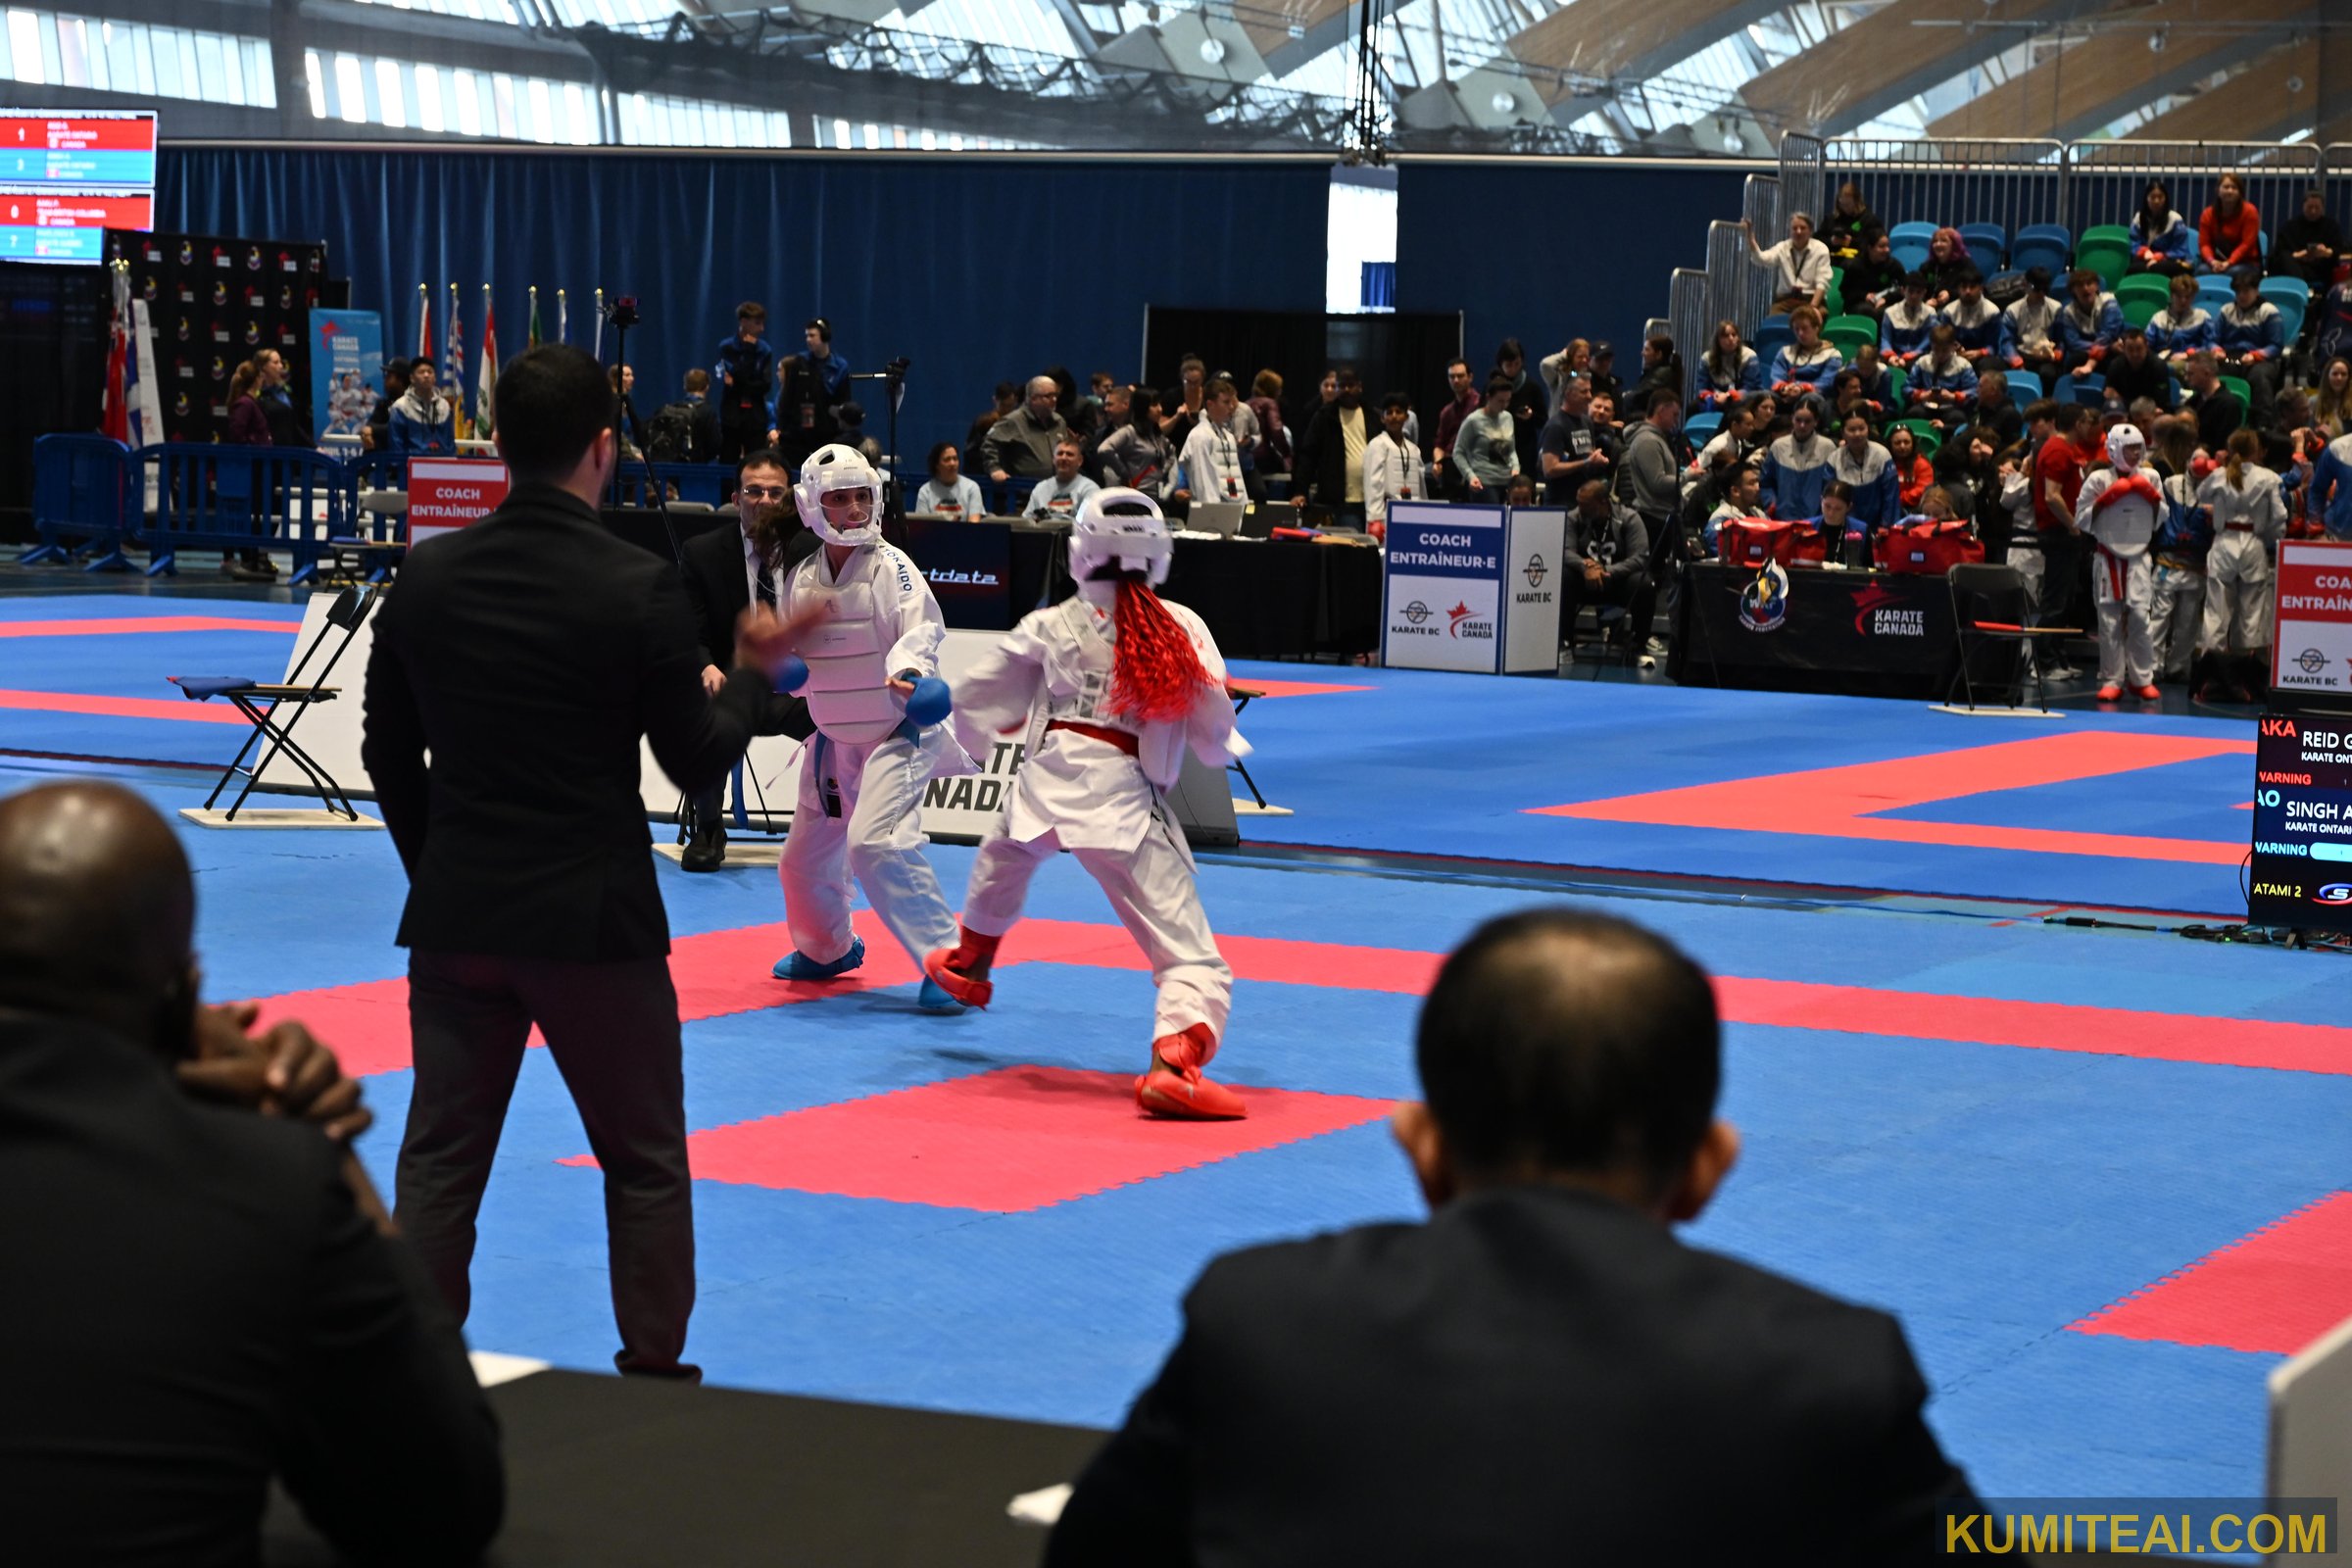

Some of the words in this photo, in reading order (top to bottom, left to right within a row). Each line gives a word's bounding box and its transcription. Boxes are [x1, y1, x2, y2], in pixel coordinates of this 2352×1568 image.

[435, 487, 480, 500] COACH
[1419, 533, 1471, 547] COACH
[921, 568, 999, 585] tdata
[2315, 575, 2352, 589] COA
[1516, 592, 1542, 603] KARATE
[1543, 592, 1551, 603] BC
[1875, 610, 1924, 623] KARATE
[1392, 625, 1426, 635] KARATE
[1428, 627, 1440, 636] BC
[1462, 621, 1493, 631] KARATE
[1874, 622, 1924, 636] CANADA
[1461, 630, 1493, 639] CANADA
[2282, 675, 2322, 685] KARATE
[2325, 677, 2338, 686] BC
[2261, 718, 2297, 737] AKA
[2302, 731, 2339, 748] REID
[2301, 751, 2333, 762] KARATE
[2259, 770, 2312, 785] WARNING
[2258, 789, 2280, 808] AO
[2286, 801, 2338, 819] SINGH
[2285, 821, 2318, 833] KARATE
[2319, 823, 2352, 835] ONTARI
[2255, 841, 2308, 856] WARNING
[2253, 882, 2291, 897] ATAMI
[2294, 885, 2302, 898] 2
